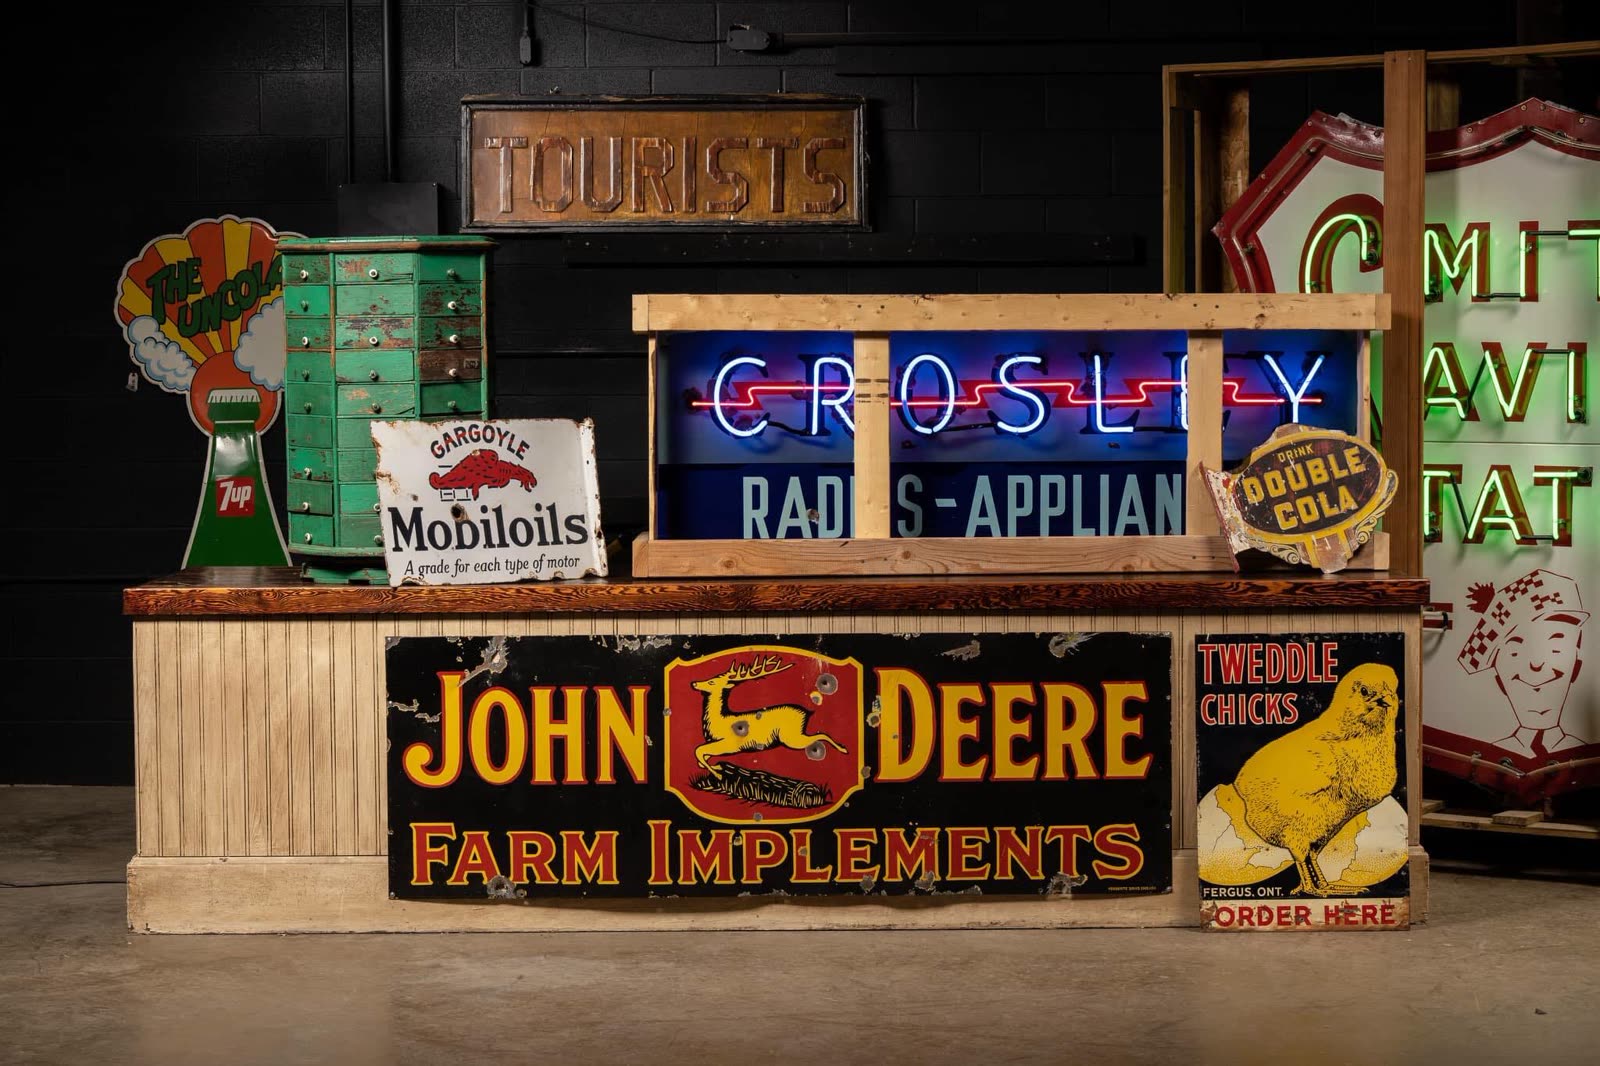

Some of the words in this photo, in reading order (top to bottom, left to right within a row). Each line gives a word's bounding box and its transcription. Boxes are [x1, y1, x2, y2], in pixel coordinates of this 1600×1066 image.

[485, 136, 847, 213] TOURISTS
[146, 257, 202, 325] THE
[430, 423, 531, 460] GARGOYLE
[1277, 443, 1315, 463] DRINK
[219, 480, 252, 512] 7up
[1242, 446, 1367, 504] DOUBLE
[387, 502, 589, 553] Mobiloils
[1273, 484, 1359, 531] COLA
[404, 560, 414, 576] A
[417, 558, 450, 579] grade
[450, 557, 470, 578] for
[473, 555, 501, 573] each
[504, 554, 529, 576] type
[532, 553, 547, 574] of
[547, 556, 581, 569] motor
[1197, 642, 1339, 685] TWEDDLE
[402, 671, 648, 789] JOHN
[875, 667, 1154, 783] DEERE
[1200, 693, 1299, 726] CHICKS
[409, 822, 620, 886] FARM
[647, 820, 1145, 886] IMPLEMENTS
[1257, 886, 1284, 897] ONT.
[1214, 904, 1312, 927] ORDER
[1323, 904, 1396, 927] HERE
